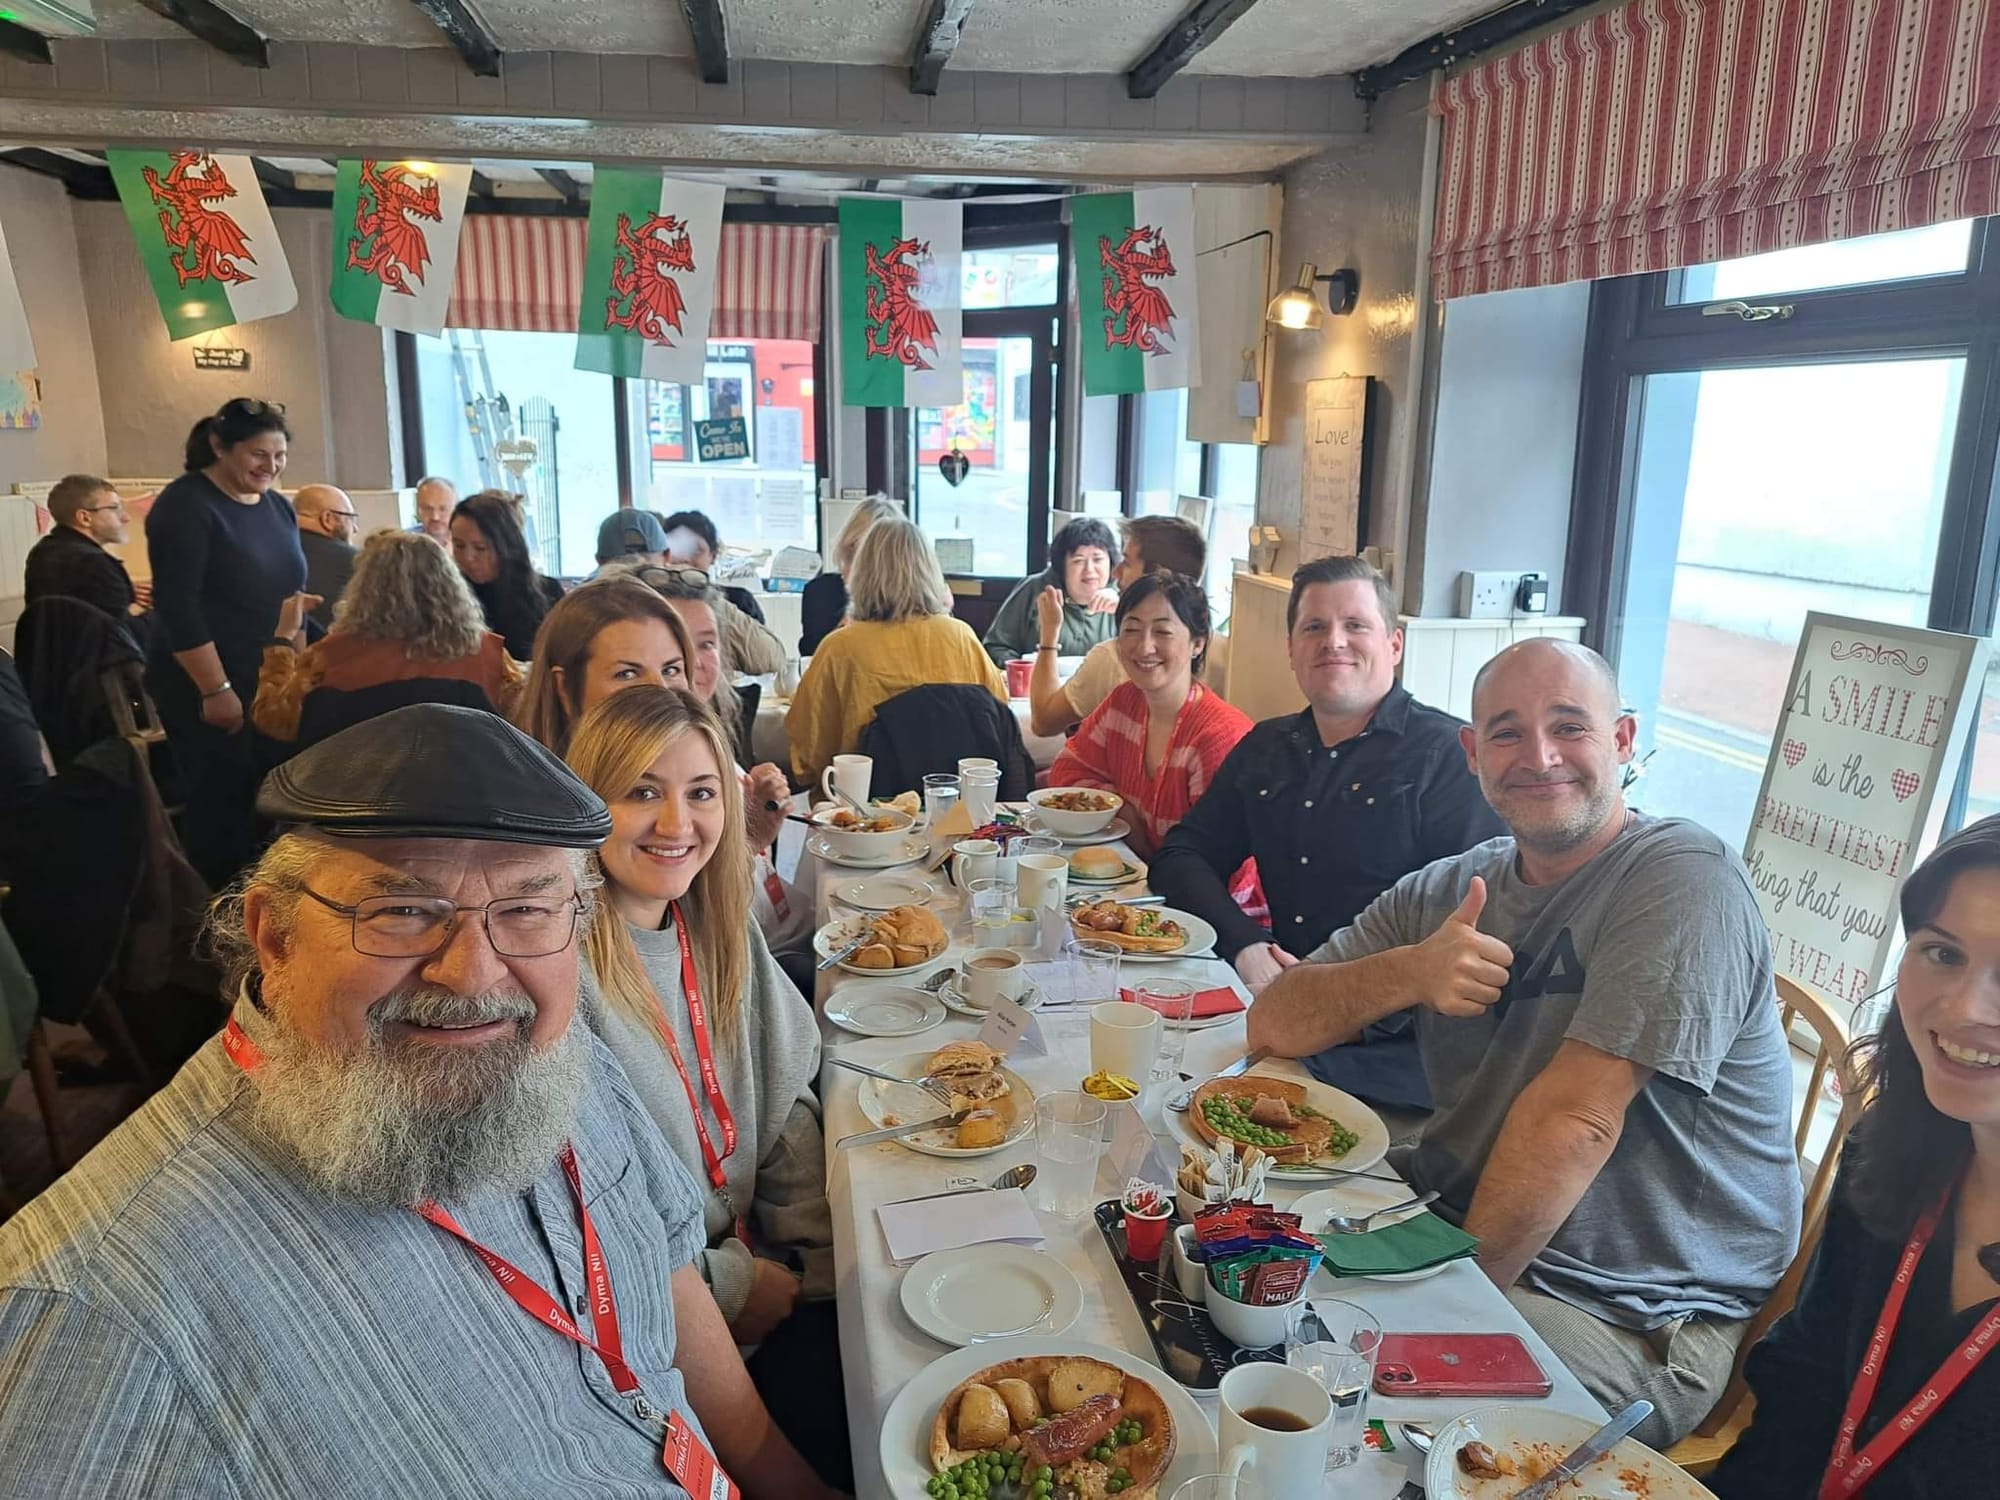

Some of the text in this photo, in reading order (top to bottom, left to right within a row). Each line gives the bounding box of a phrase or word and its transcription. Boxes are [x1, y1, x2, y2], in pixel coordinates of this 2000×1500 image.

[701, 422, 726, 438] Come
[1315, 419, 1350, 444] Love
[702, 441, 746, 458] OPEN
[1787, 668, 1949, 749] A SMILE
[1812, 752, 1875, 800] is the
[1755, 795, 1912, 879] PRETTIEST
[1797, 869, 1840, 922] that
[1840, 899, 1889, 943] you
[1788, 944, 1870, 1006] WEAR
[496, 1266, 516, 1284] Ni!
[1897, 1252, 1915, 1283] Dyma
[596, 1276, 610, 1314] Dyma
[1265, 1292, 1293, 1301] MALT
[549, 1307, 576, 1335] Dyma
[1863, 1344, 1881, 1376] Dyma
[1910, 1389, 1938, 1416] Dyma
[676, 1444, 688, 1477] DYMA
